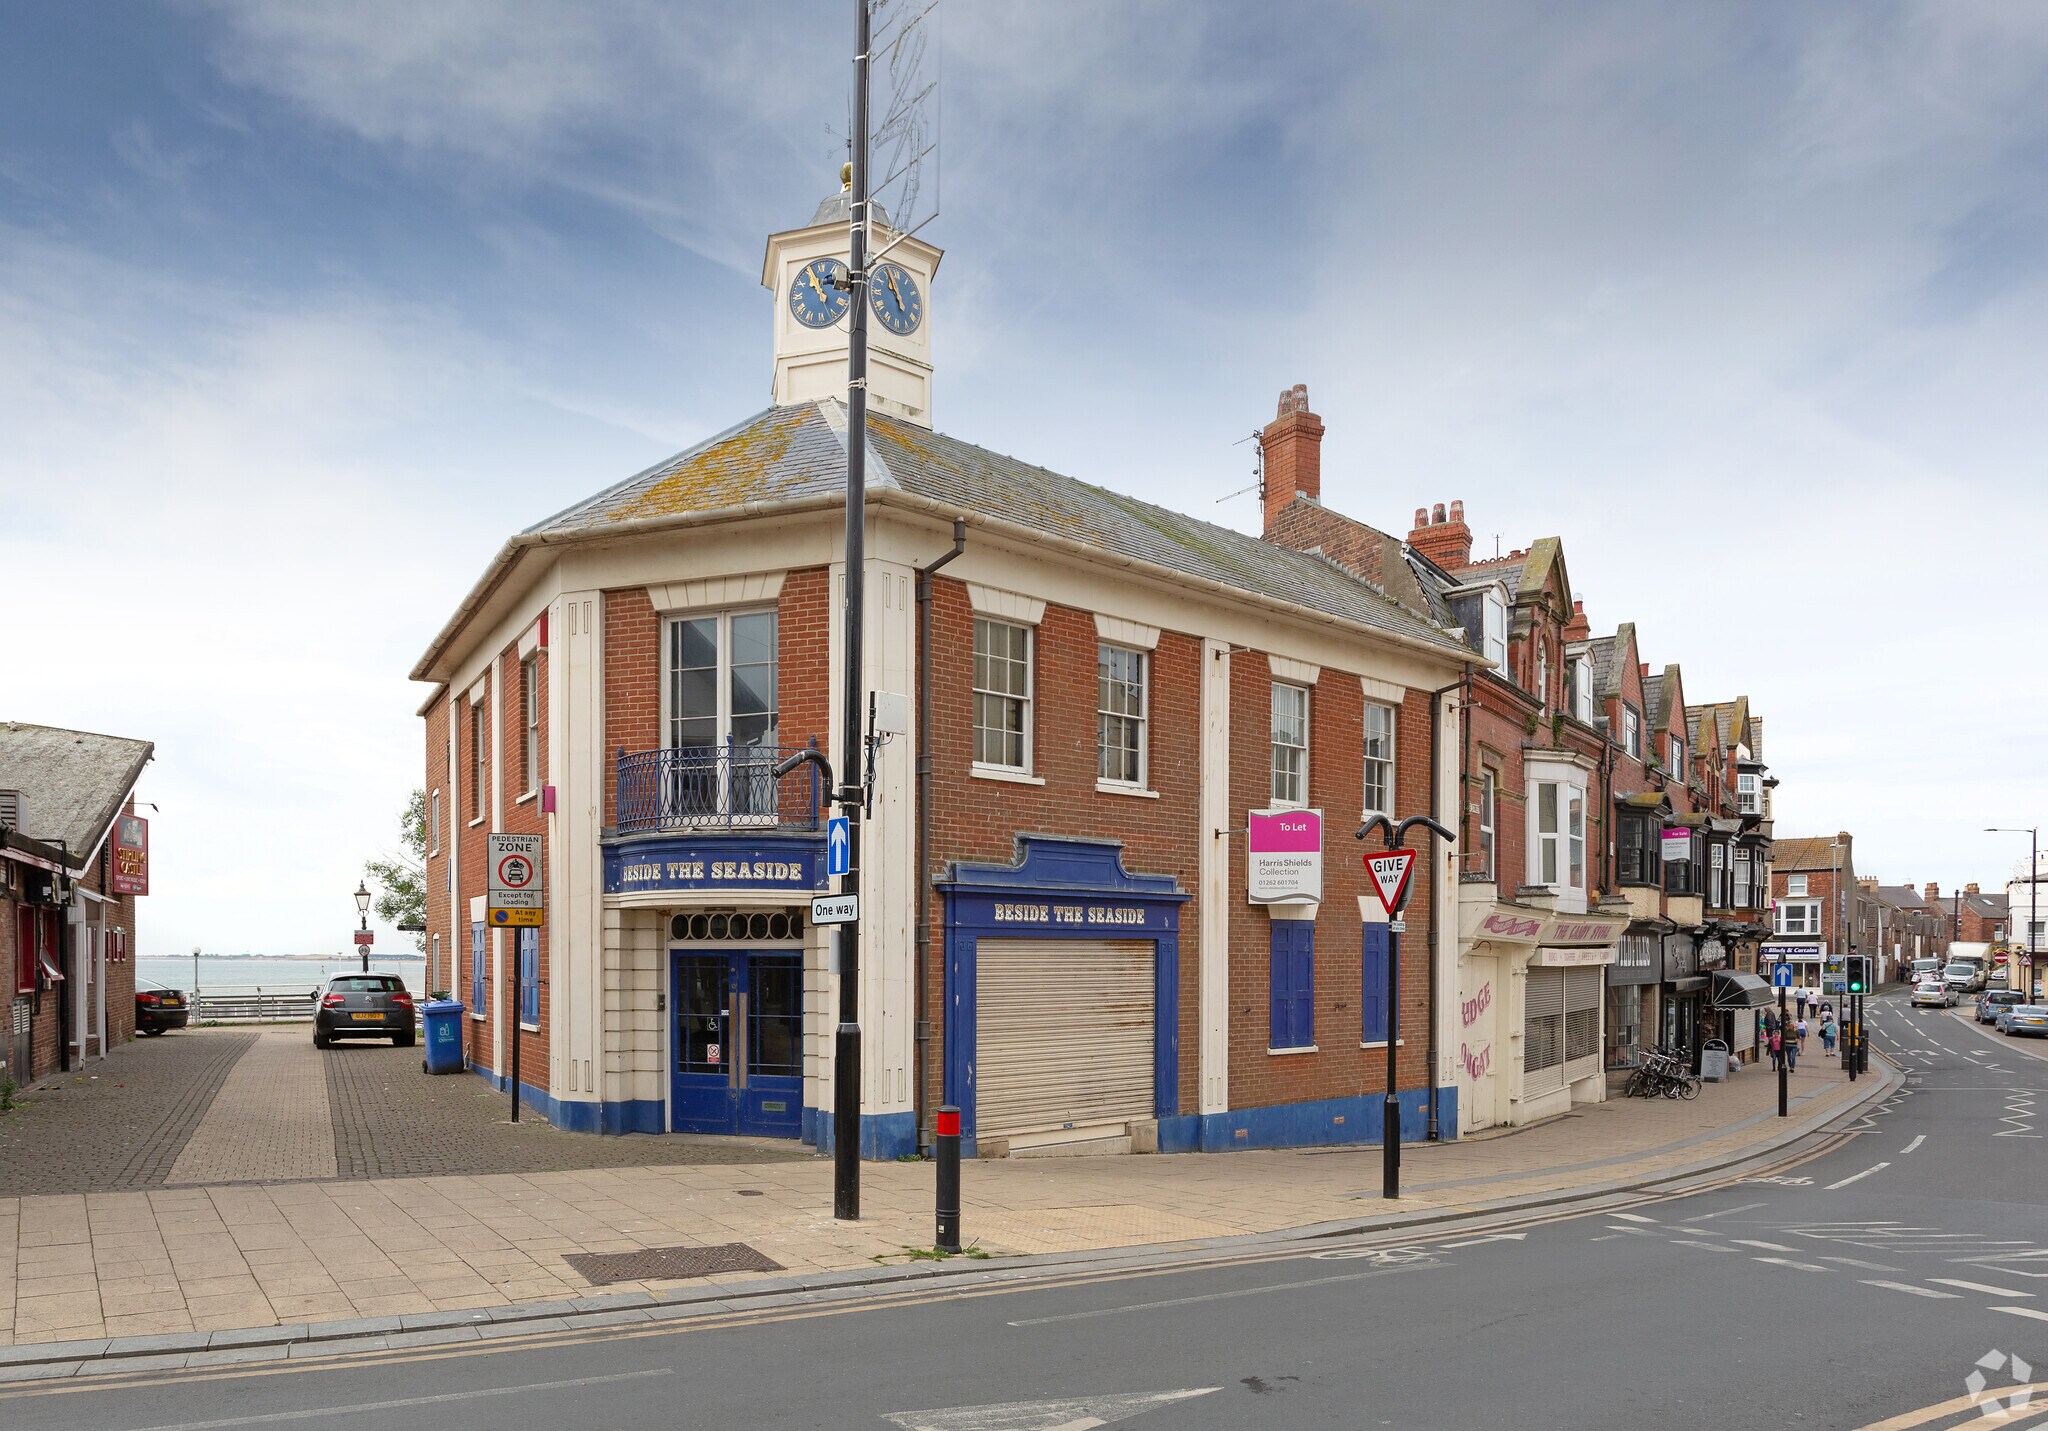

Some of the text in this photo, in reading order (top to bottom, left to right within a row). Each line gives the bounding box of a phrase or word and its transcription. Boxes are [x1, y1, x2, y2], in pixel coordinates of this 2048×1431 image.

[1280, 822, 1307, 831] To Let
[498, 843, 532, 852] ZONE
[120, 861, 144, 876] CASTLE
[1259, 859, 1313, 867] Harris Shields
[1374, 858, 1403, 873] GIVE
[622, 861, 802, 882] BESIDE THE SEASIDE
[1259, 867, 1299, 876] Collection
[1380, 874, 1399, 884] WAY
[498, 892, 521, 900] Except
[815, 903, 854, 917] One way
[994, 903, 1145, 924] BESIDE THE SEASIDE
[1461, 981, 1491, 1028] UDGE
